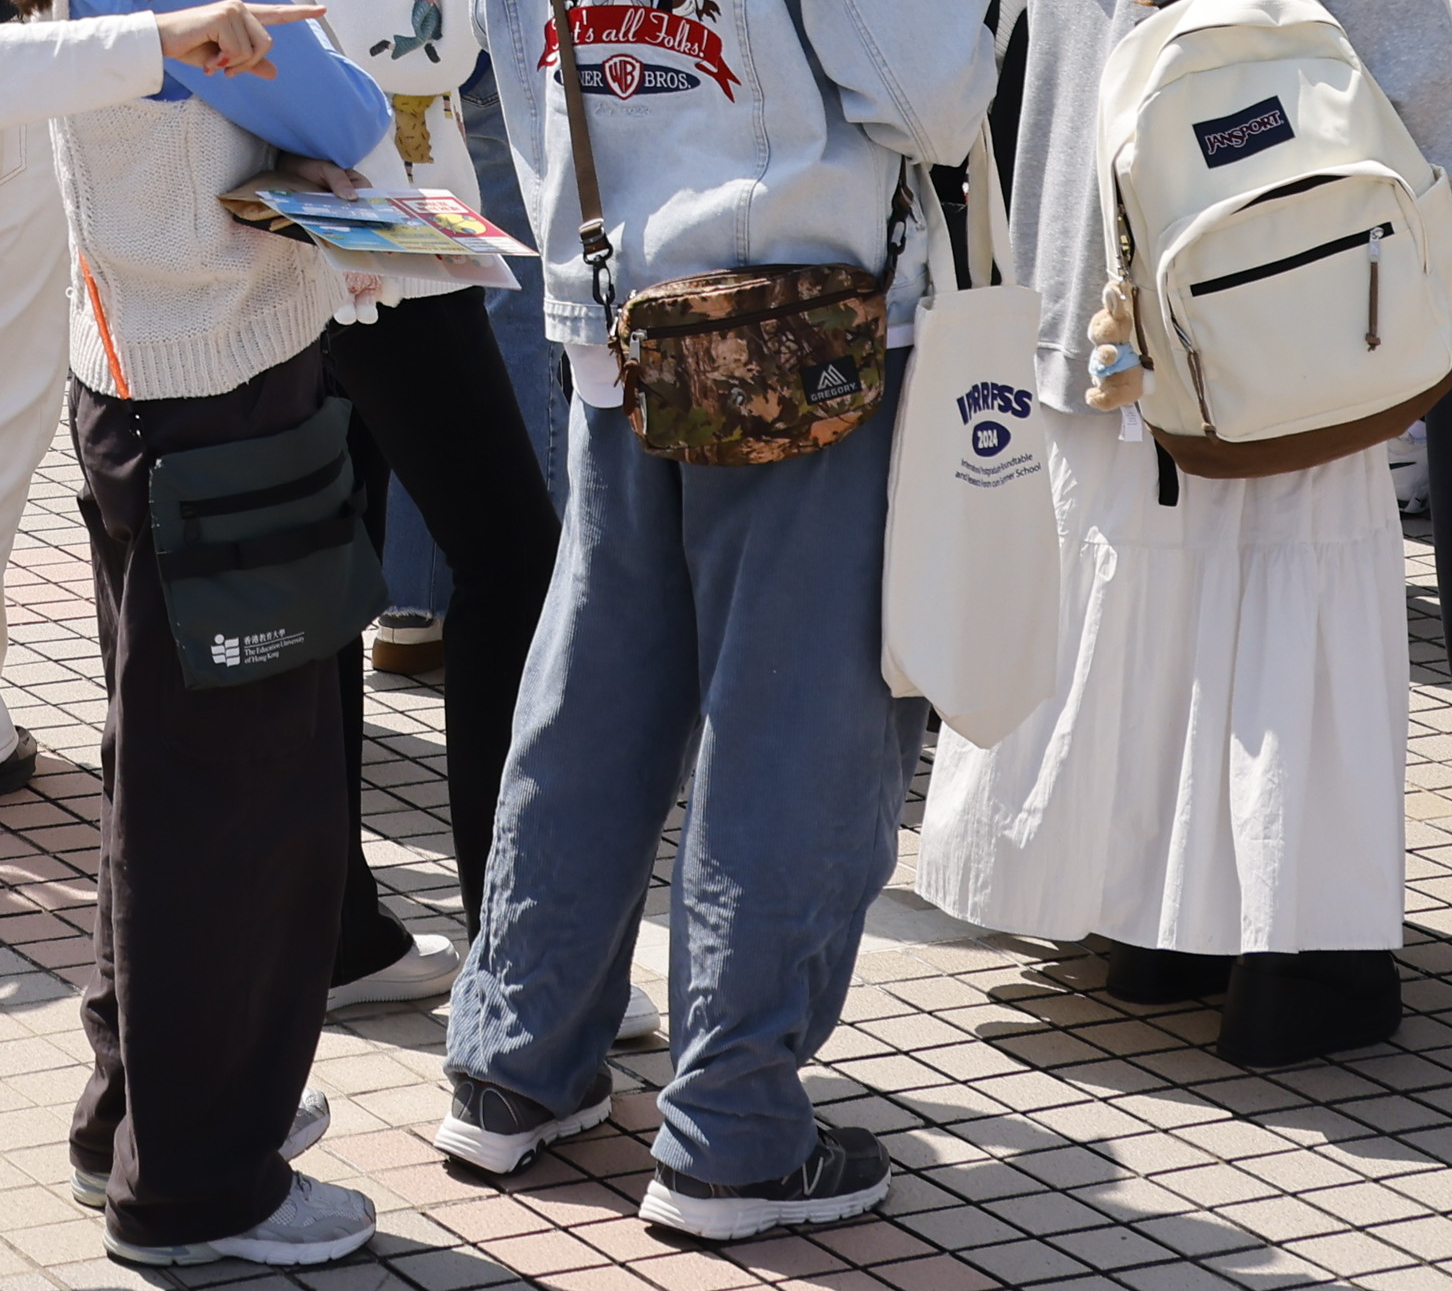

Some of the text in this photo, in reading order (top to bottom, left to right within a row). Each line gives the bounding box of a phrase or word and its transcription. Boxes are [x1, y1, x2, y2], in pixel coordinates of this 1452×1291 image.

[602, 8, 645, 42] all
[645, 11, 709, 58] Folks!
[644, 70, 692, 90] BROS.
[1205, 110, 1282, 155] JANSPORT
[977, 429, 998, 449] 2024
[1016, 462, 1042, 478] School
[244, 628, 286, 646] 香港教育大學
[244, 648, 256, 657] The
[256, 643, 280, 655] Education
[244, 656, 254, 664] of
